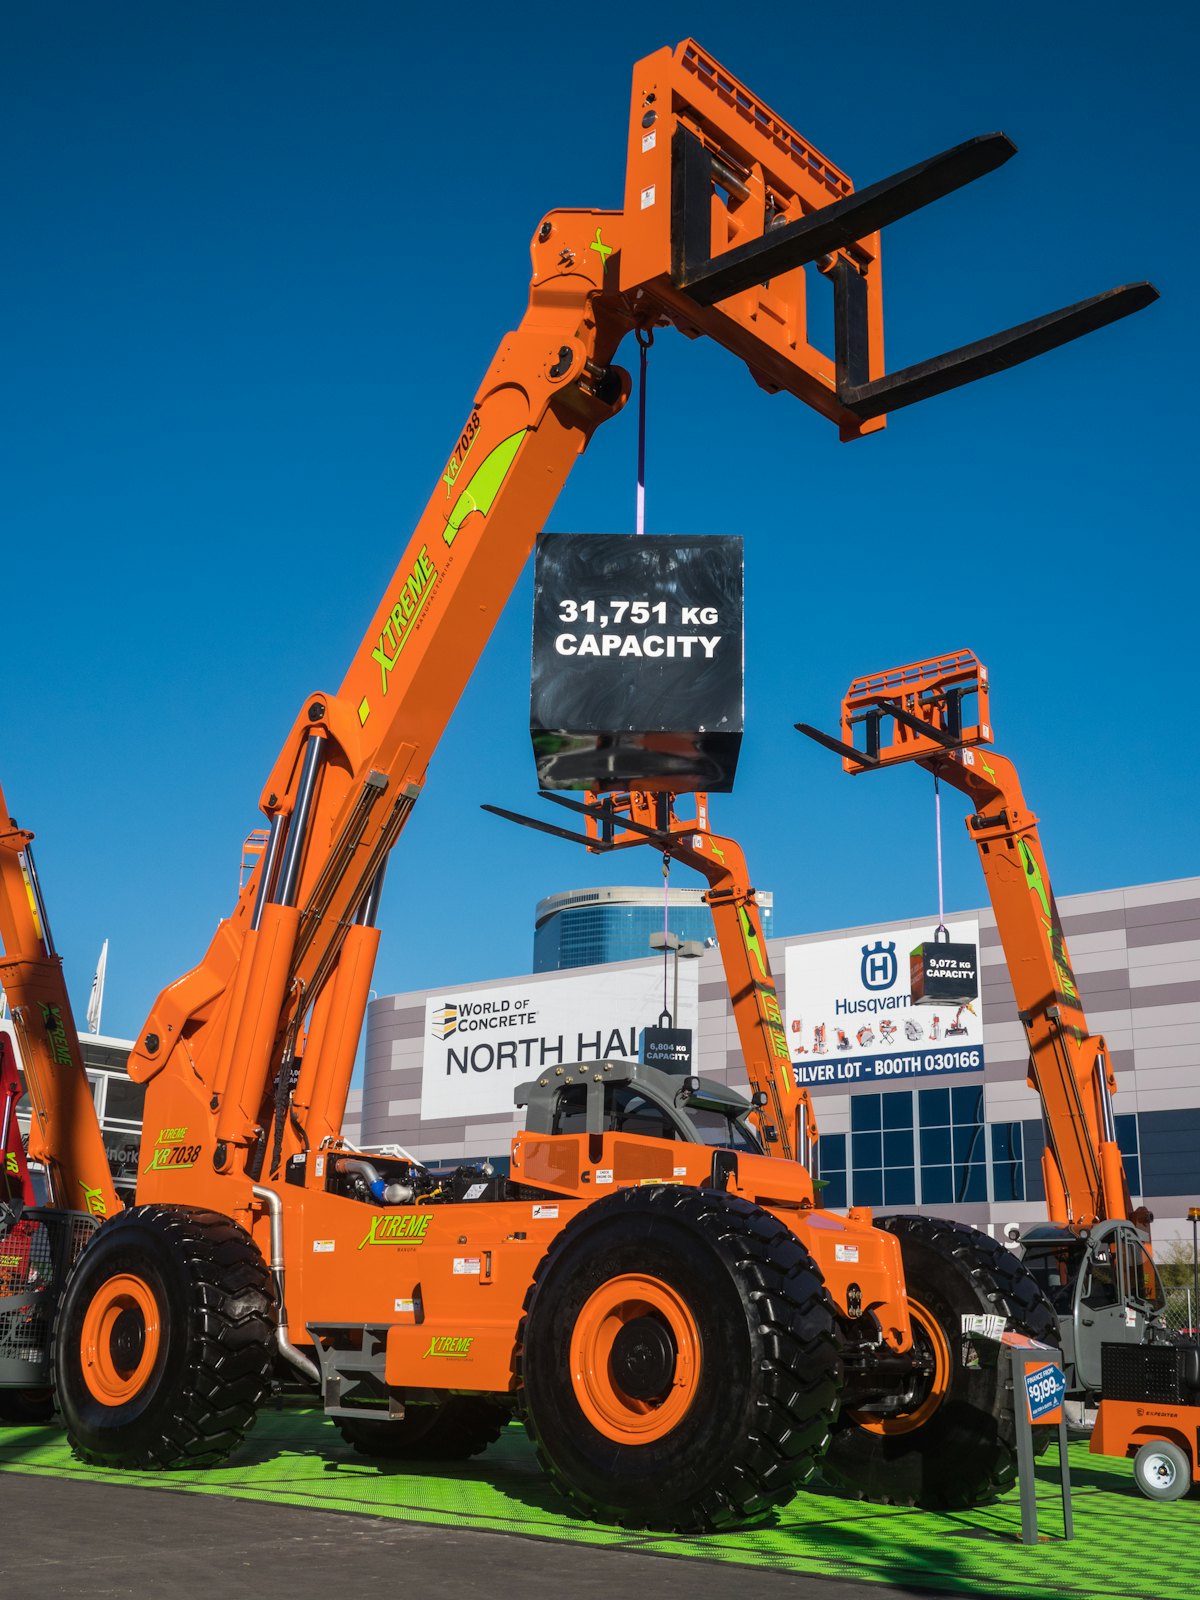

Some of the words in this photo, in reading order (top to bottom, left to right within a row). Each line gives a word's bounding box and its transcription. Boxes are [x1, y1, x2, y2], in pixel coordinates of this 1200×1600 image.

[415, 556, 454, 631] MANUFACTURING
[371, 543, 438, 696] XTREME
[558, 599, 667, 628] 31,751
[681, 607, 719, 625] KG
[555, 633, 722, 658] CAPACITY
[926, 969, 975, 979] CAPACITY
[929, 958, 958, 969] 9,072
[458, 999, 510, 1018] WORLD
[514, 999, 530, 1010] OF
[457, 1012, 537, 1033] CONCRETE
[446, 1035, 564, 1076] NORTH
[646, 1052, 690, 1061] CAPACITY
[649, 1042, 675, 1052] 6,804
[792, 1063, 834, 1083] SILVER
[837, 1062, 862, 1079] LOT
[874, 1056, 921, 1075] BOOTH
[924, 1050, 980, 1072] 030166
[154, 1127, 189, 1146] XTREME
[357, 1214, 434, 1250] XTREME
[422, 1336, 474, 1359] XTREME
